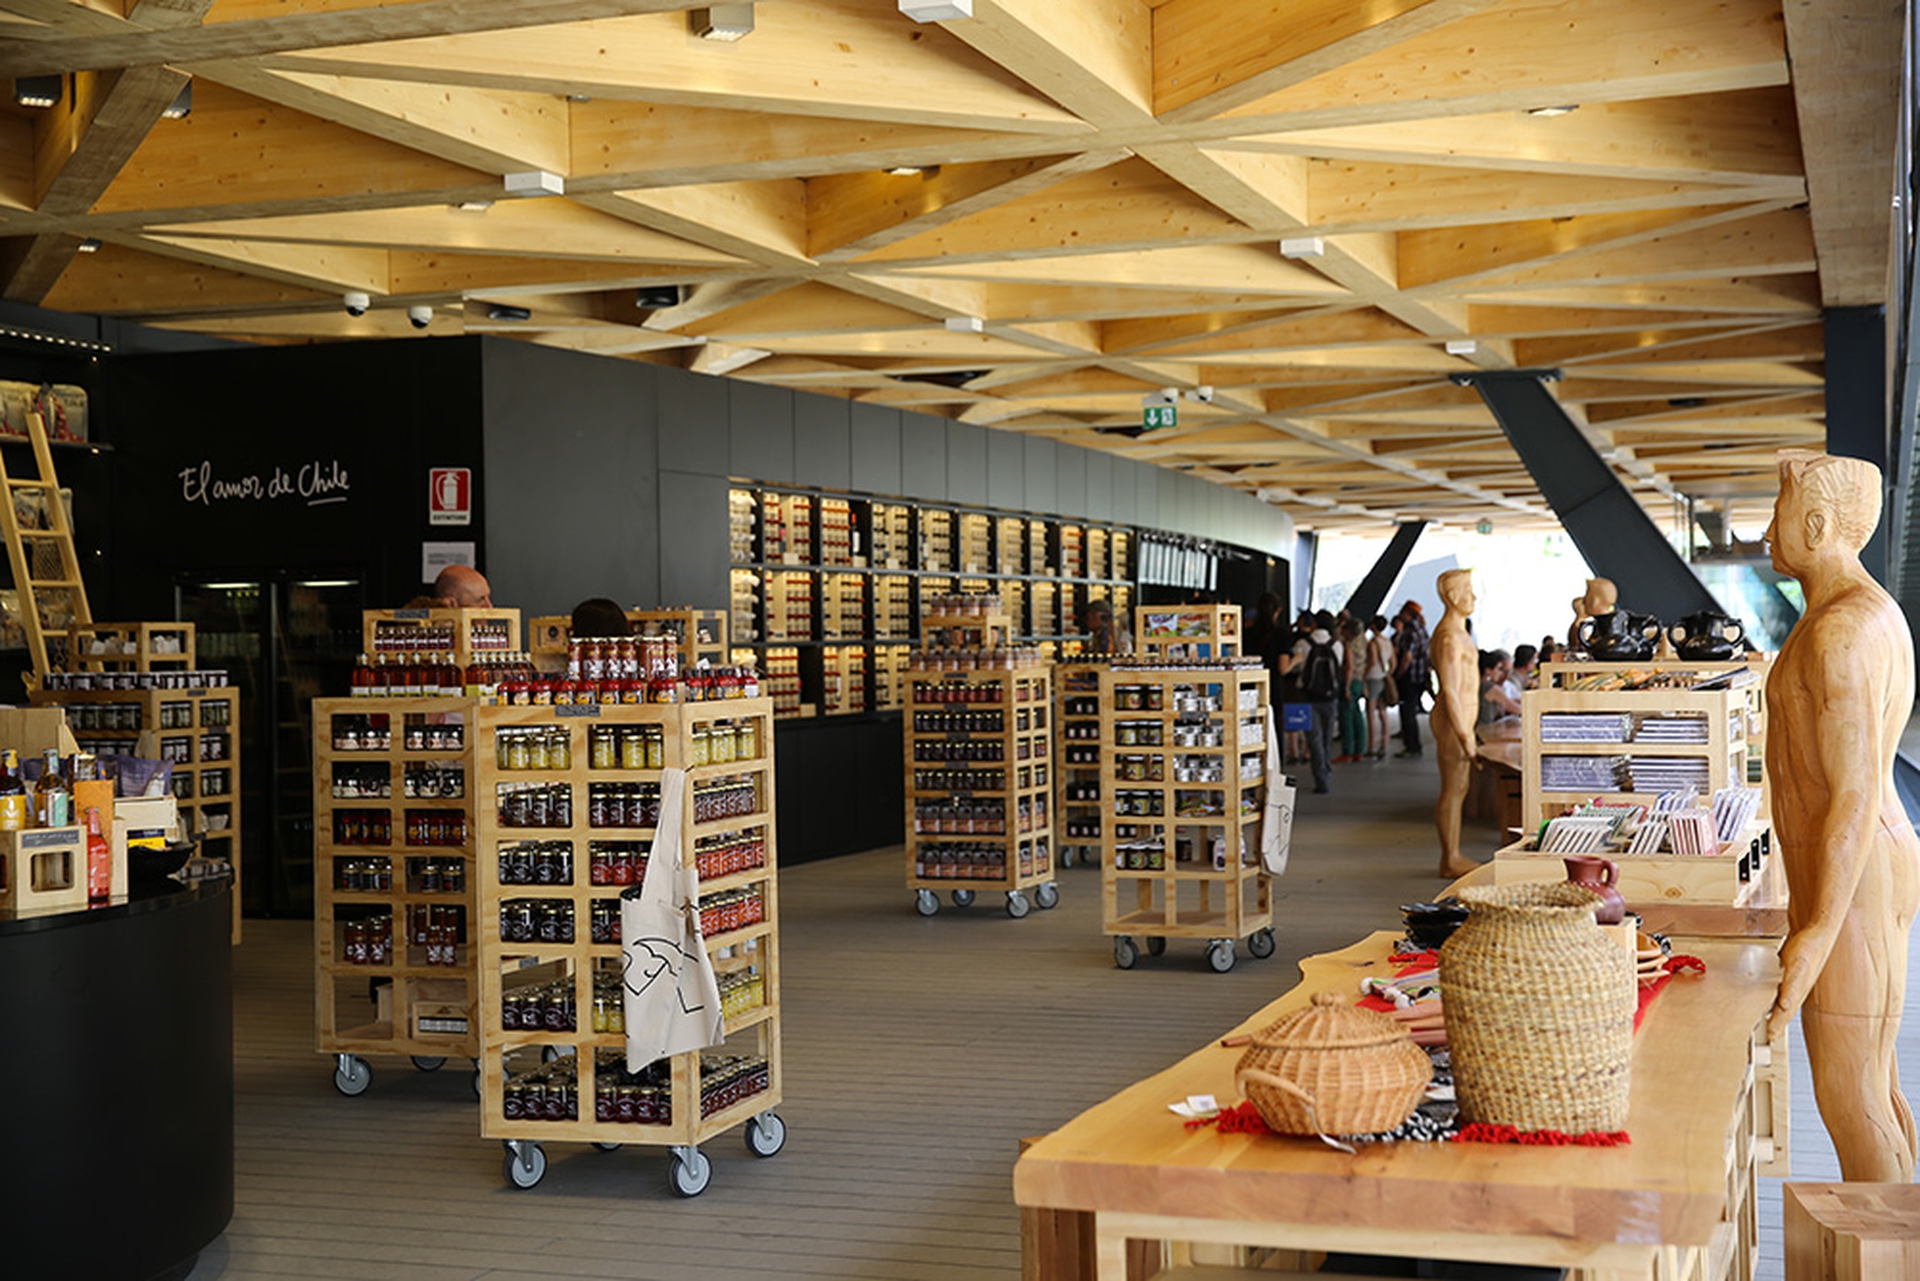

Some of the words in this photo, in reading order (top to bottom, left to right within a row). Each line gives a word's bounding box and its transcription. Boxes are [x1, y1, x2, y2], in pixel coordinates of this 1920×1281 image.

[178, 460, 211, 505] El
[213, 475, 264, 499] amor
[268, 467, 295, 498] de
[298, 460, 350, 498] Chile
